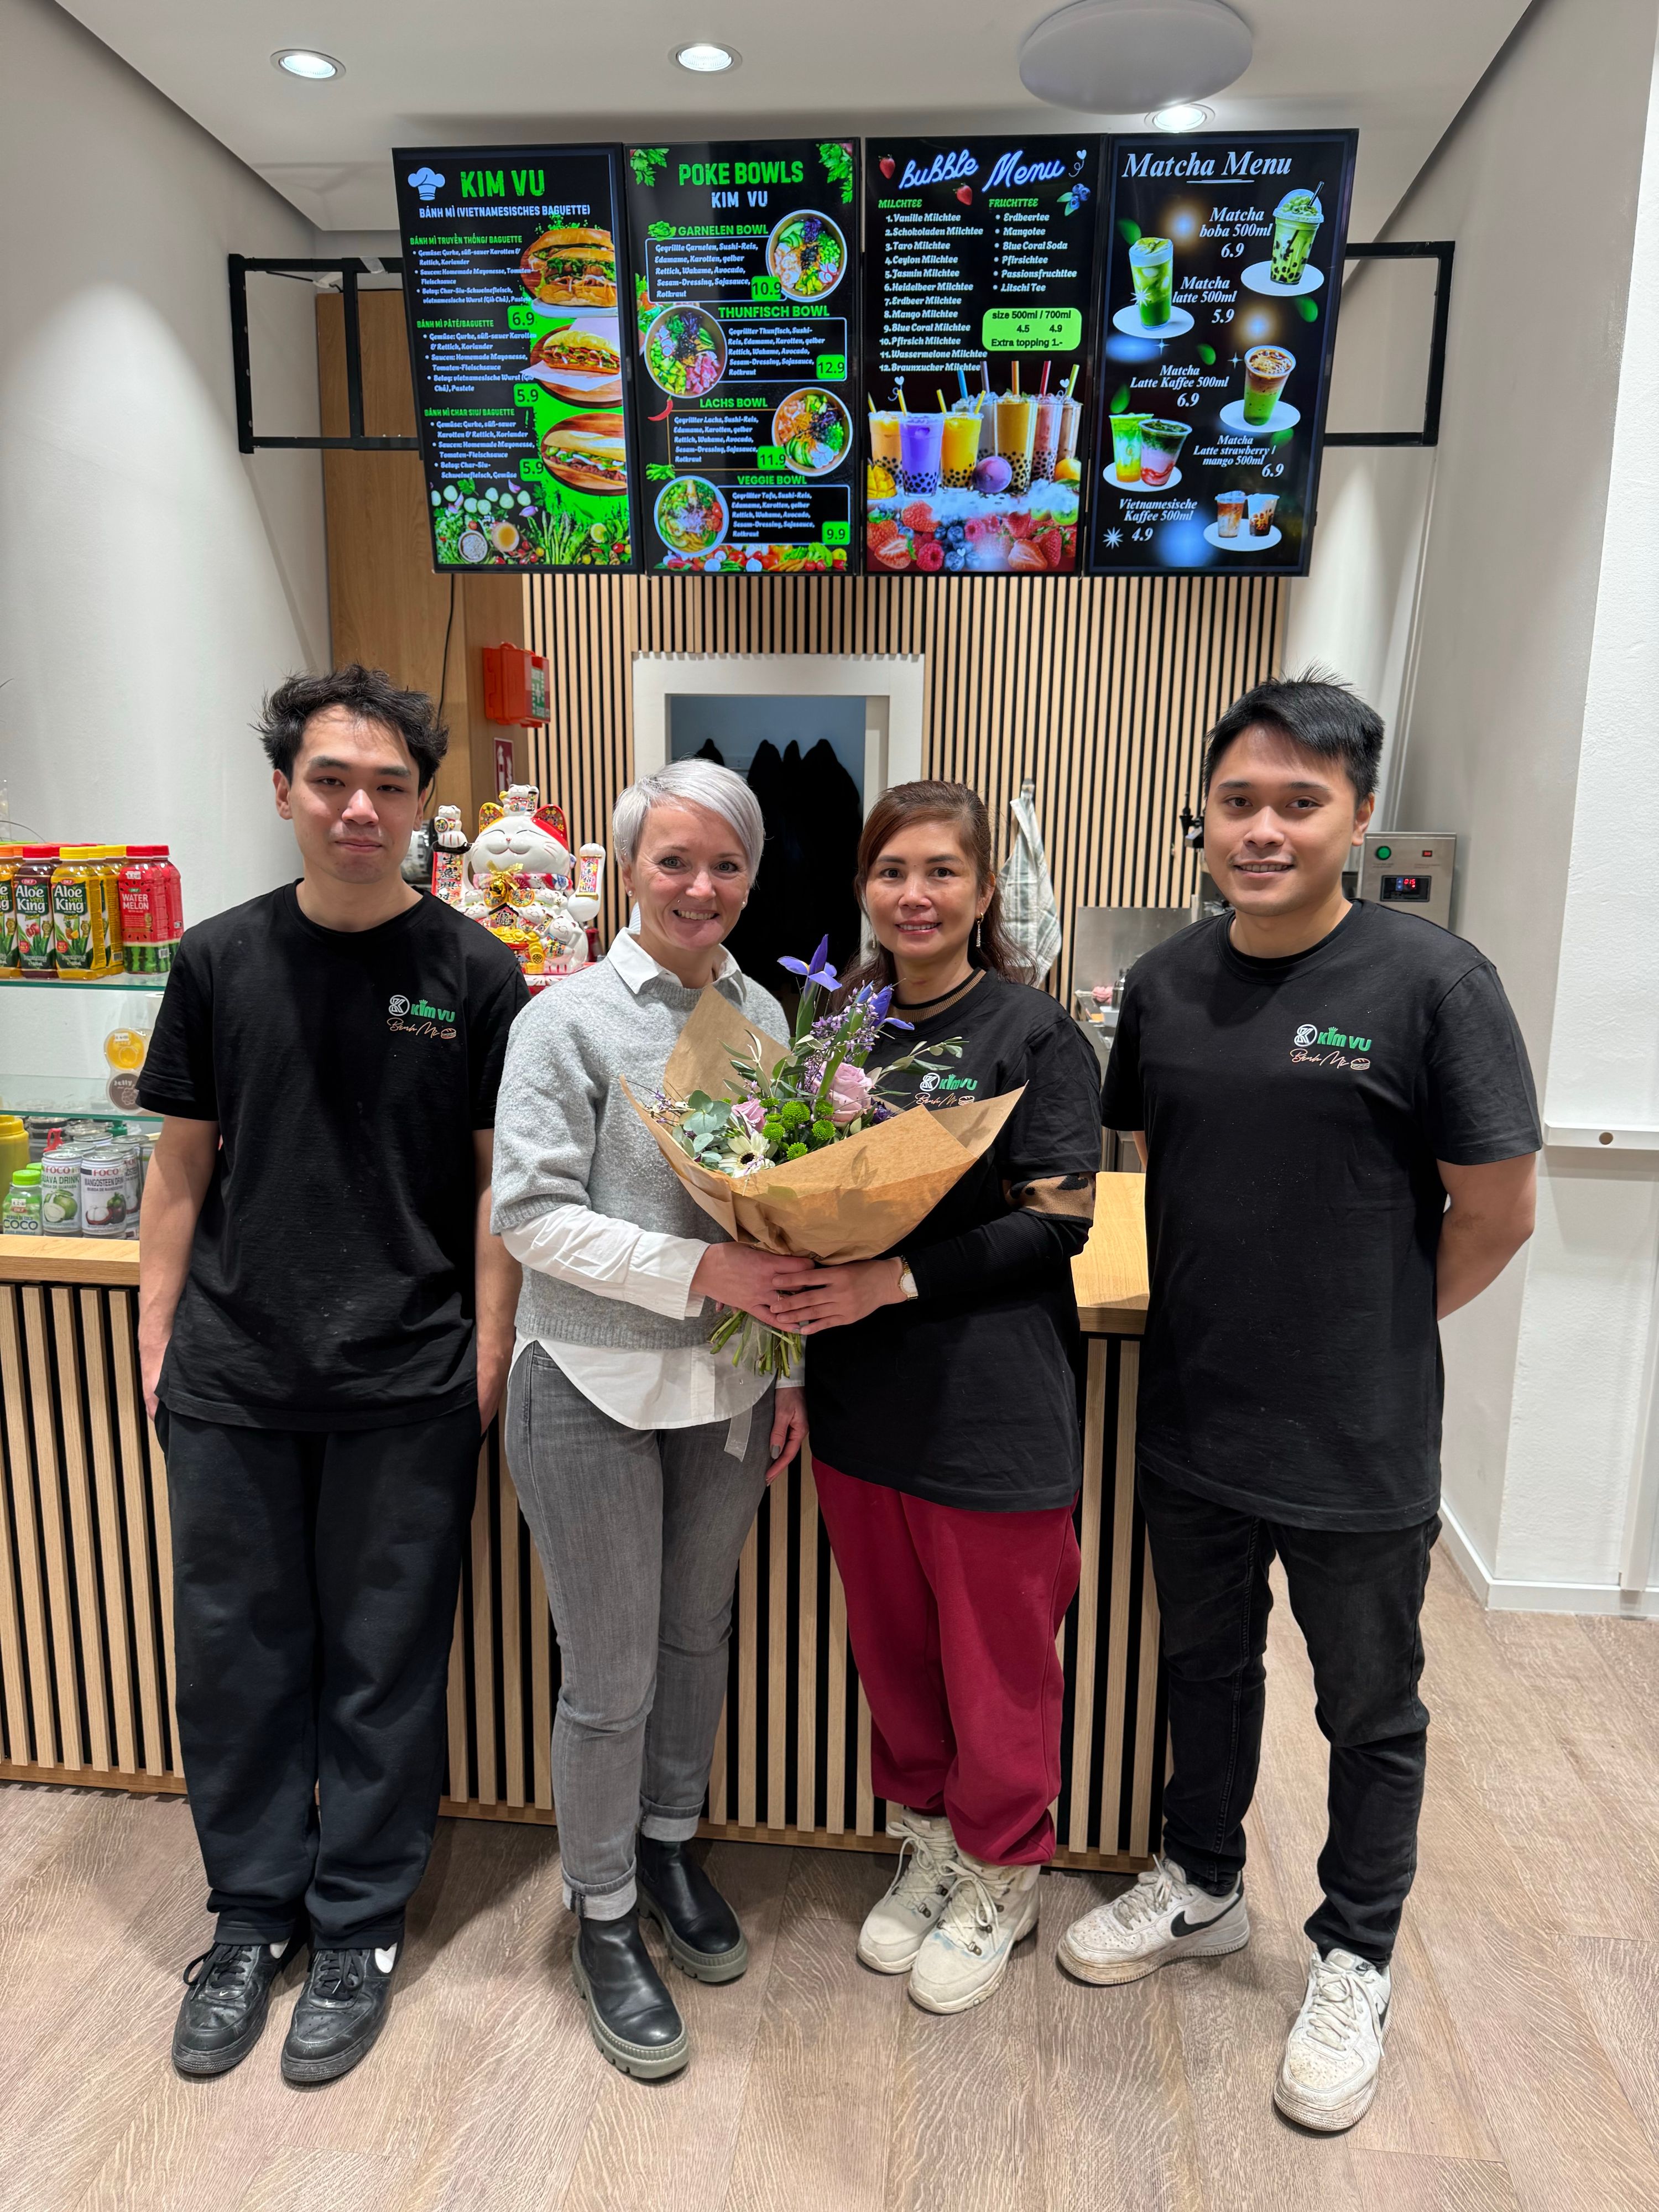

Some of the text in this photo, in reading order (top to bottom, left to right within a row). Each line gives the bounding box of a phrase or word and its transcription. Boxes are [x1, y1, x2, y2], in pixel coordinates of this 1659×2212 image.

[982, 149, 1065, 192] Menu
[1121, 151, 1292, 178] Matcha Menu
[679, 161, 804, 186] POKE BOWLS
[461, 170, 545, 197] KIM VU
[712, 191, 768, 208] KIM VU
[878, 199, 922, 208] MILCHTEE
[989, 199, 1039, 207] FRUCHTTEE
[457, 206, 540, 218] (VIETNAMESISCHES
[542, 205, 590, 216] BAGUETTE)
[924, 213, 961, 222] Milchtee
[1004, 213, 1050, 221] Erdbeertee
[1209, 207, 1264, 222] Matcha
[678, 225, 768, 236] GARNELEN BOWL
[946, 227, 983, 235] Milchtee
[1003, 227, 1046, 237] Mangotee
[1199, 223, 1273, 237] boba 500ml
[914, 241, 951, 249] Milchtee
[1003, 241, 1068, 250] Blue Coral Soda
[1221, 243, 1244, 258] 6.9
[723, 255, 744, 264] gelber
[921, 255, 958, 263] Milchtee
[1002, 255, 1048, 266] Pfirsichtee
[655, 267, 681, 275] Rettich,
[923, 269, 959, 277] Milchtee
[1001, 269, 1077, 280] Passionsfruchttee
[657, 278, 750, 287] Sesam-Dressing, Sojasauce,
[752, 282, 782, 295] 10.9
[937, 283, 973, 291] Milchtee
[1000, 283, 1046, 292] Litschi Tee
[1181, 276, 1230, 290] Matcha
[1173, 291, 1237, 304] latte 500ml
[718, 305, 830, 318] THUNFISCH BOWL
[1040, 310, 1043, 319] /
[1045, 310, 1071, 319] 700ml
[1212, 309, 1234, 323] 5.9
[513, 312, 534, 326] 6.9
[1016, 338, 1049, 348] topping
[952, 349, 988, 358] Milchtee
[818, 362, 844, 374] 12.9
[1160, 364, 1199, 376] Matcha
[1130, 376, 1229, 390] Latte Kaffee 500ml
[517, 389, 539, 403] 5.9
[1177, 393, 1199, 407] 6.9
[700, 398, 768, 408] LACHS BOWL
[1217, 435, 1253, 445] Matcha
[1193, 446, 1218, 455] Latte
[1220, 446, 1270, 457] strawberry
[760, 454, 786, 466] 11.9
[1203, 455, 1265, 467] mango 500ml
[523, 462, 544, 474] 5.9
[1262, 463, 1284, 477] 6.9
[737, 476, 807, 484] VEGGIE BOWL
[1119, 499, 1197, 510] Vietnamesische
[1124, 510, 1193, 523] Kaffee 500ml
[827, 529, 846, 540] 9.9
[1131, 528, 1153, 541] 4.9
[15, 885, 44, 897] Aloe
[55, 885, 82, 897] Aloe
[17, 898, 45, 912] King
[56, 898, 84, 912] King
[437, 1008, 455, 1022] VU
[1349, 1036, 1372, 1051] VU
[59, 1176, 79, 1184] DRINK
[4, 1219, 38, 1230] COCO
